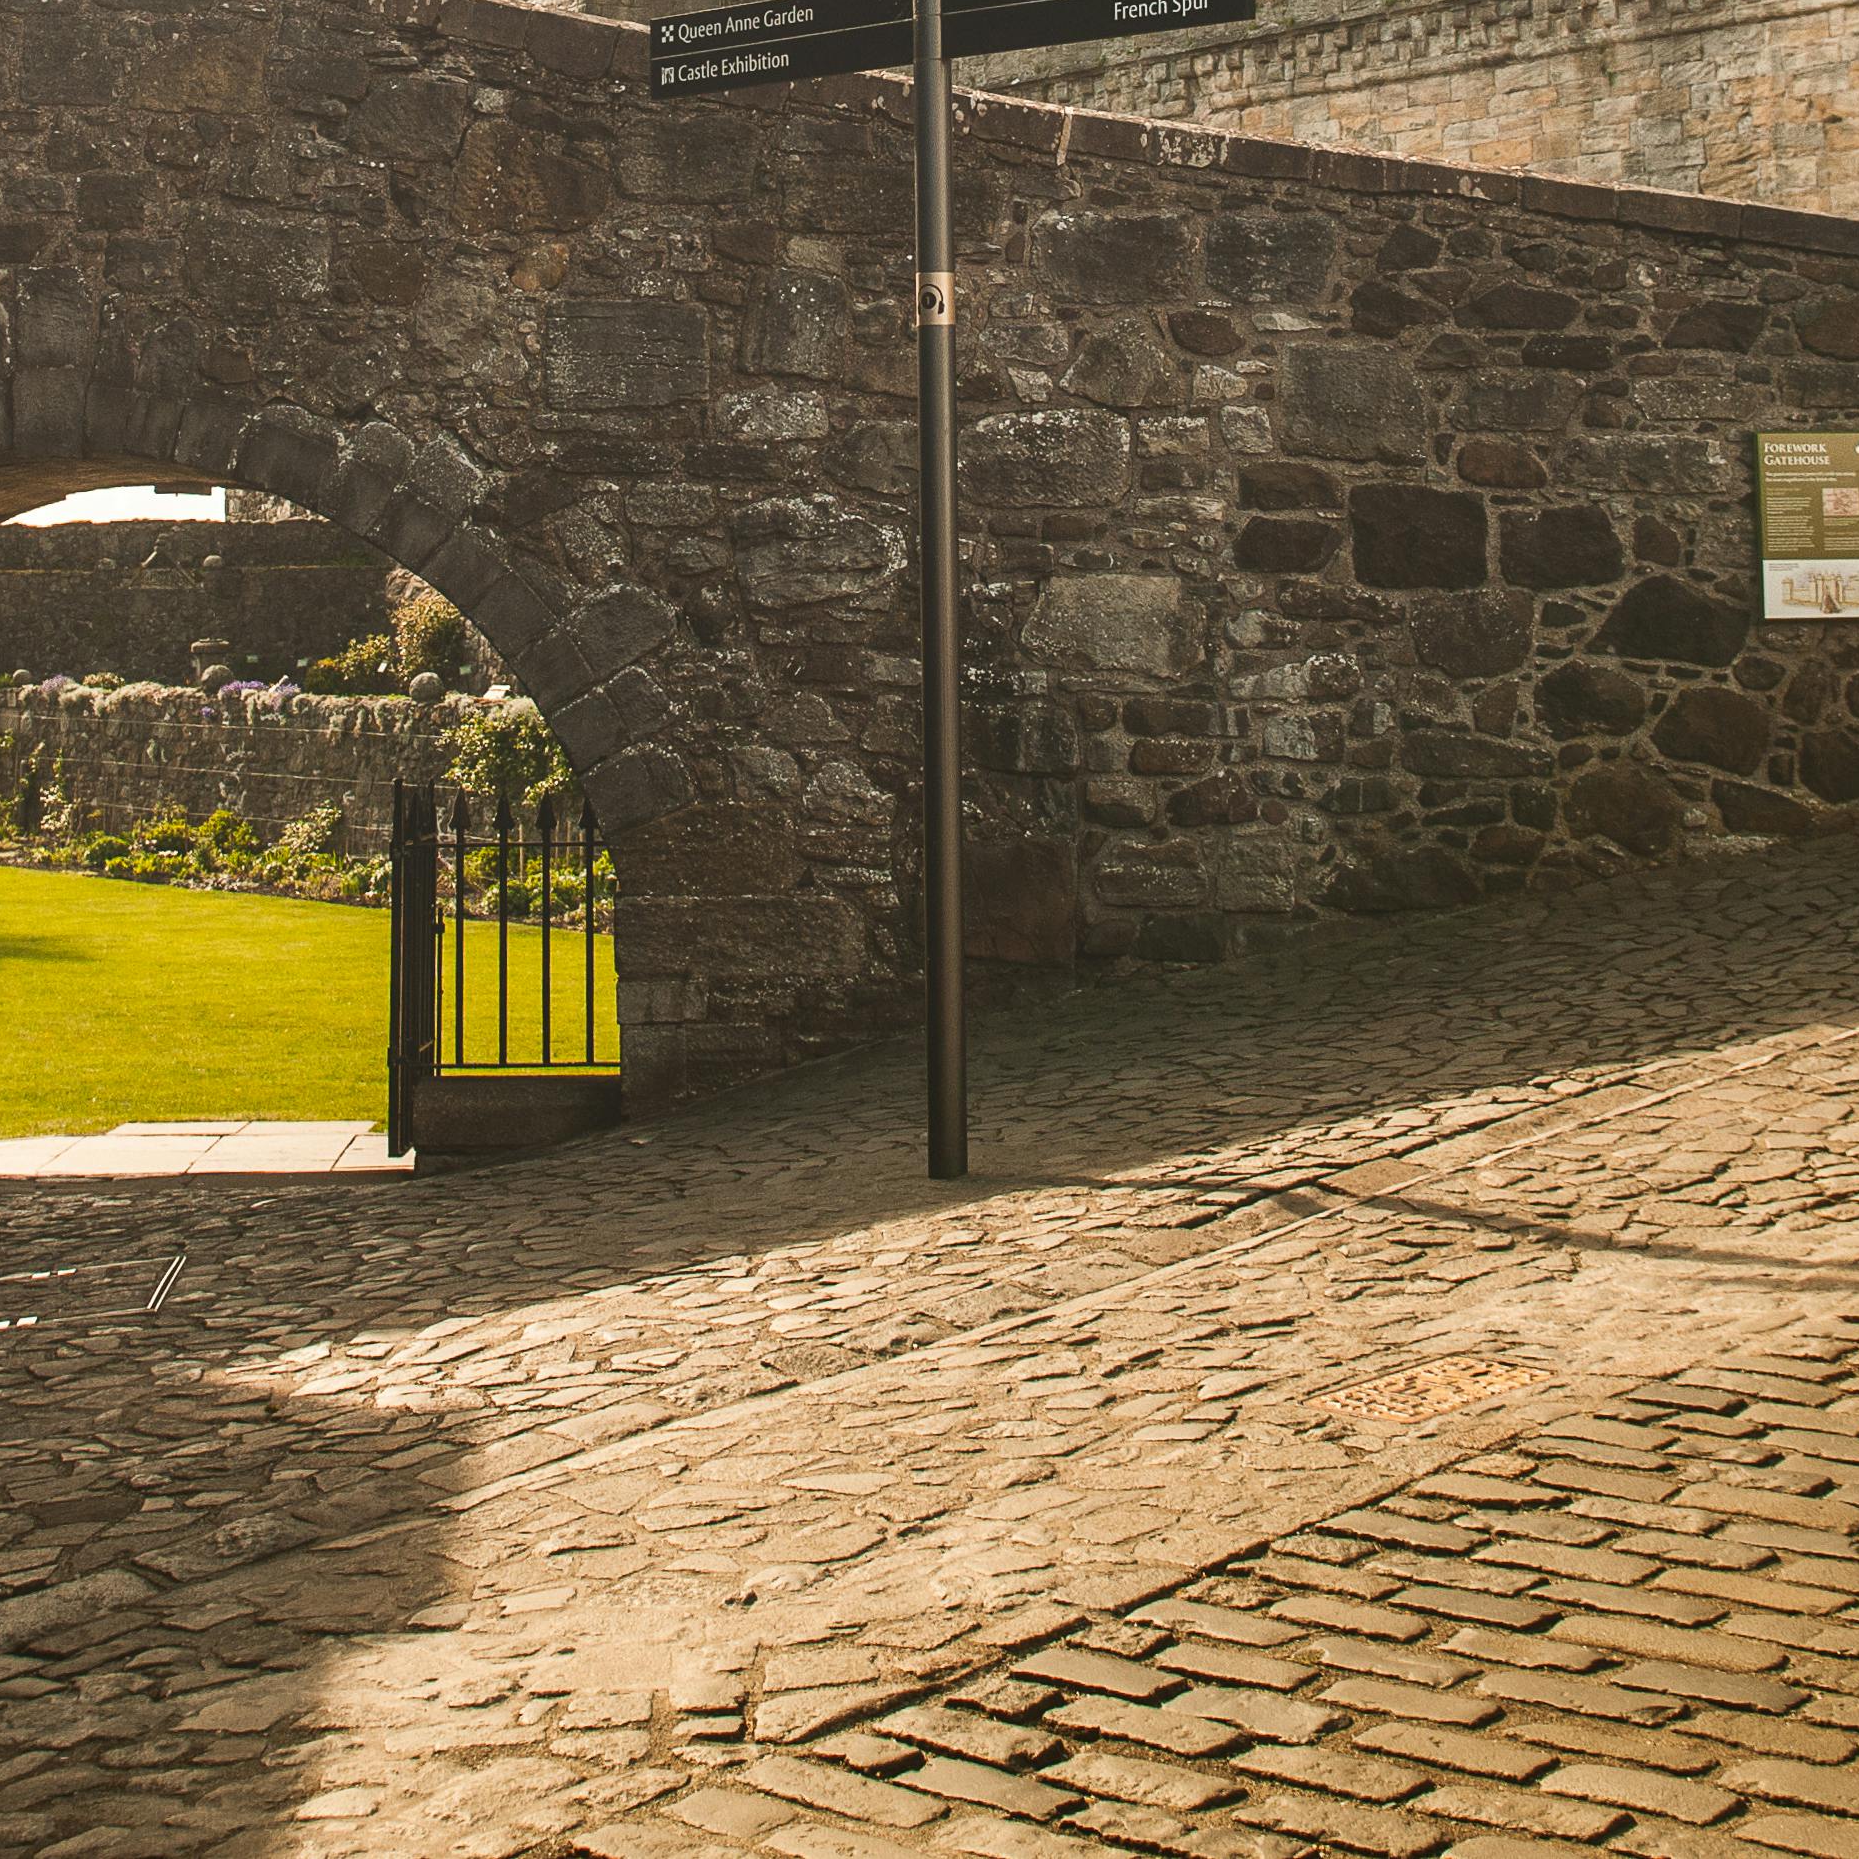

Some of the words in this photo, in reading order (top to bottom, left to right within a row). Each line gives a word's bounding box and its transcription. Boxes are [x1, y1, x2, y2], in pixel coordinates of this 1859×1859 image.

[678, 22, 722, 44] Queen
[724, 16, 760, 34] Anne
[763, 4, 814, 27] Garden
[678, 62, 718, 82] Castle
[721, 52, 789, 76] Exhibition
